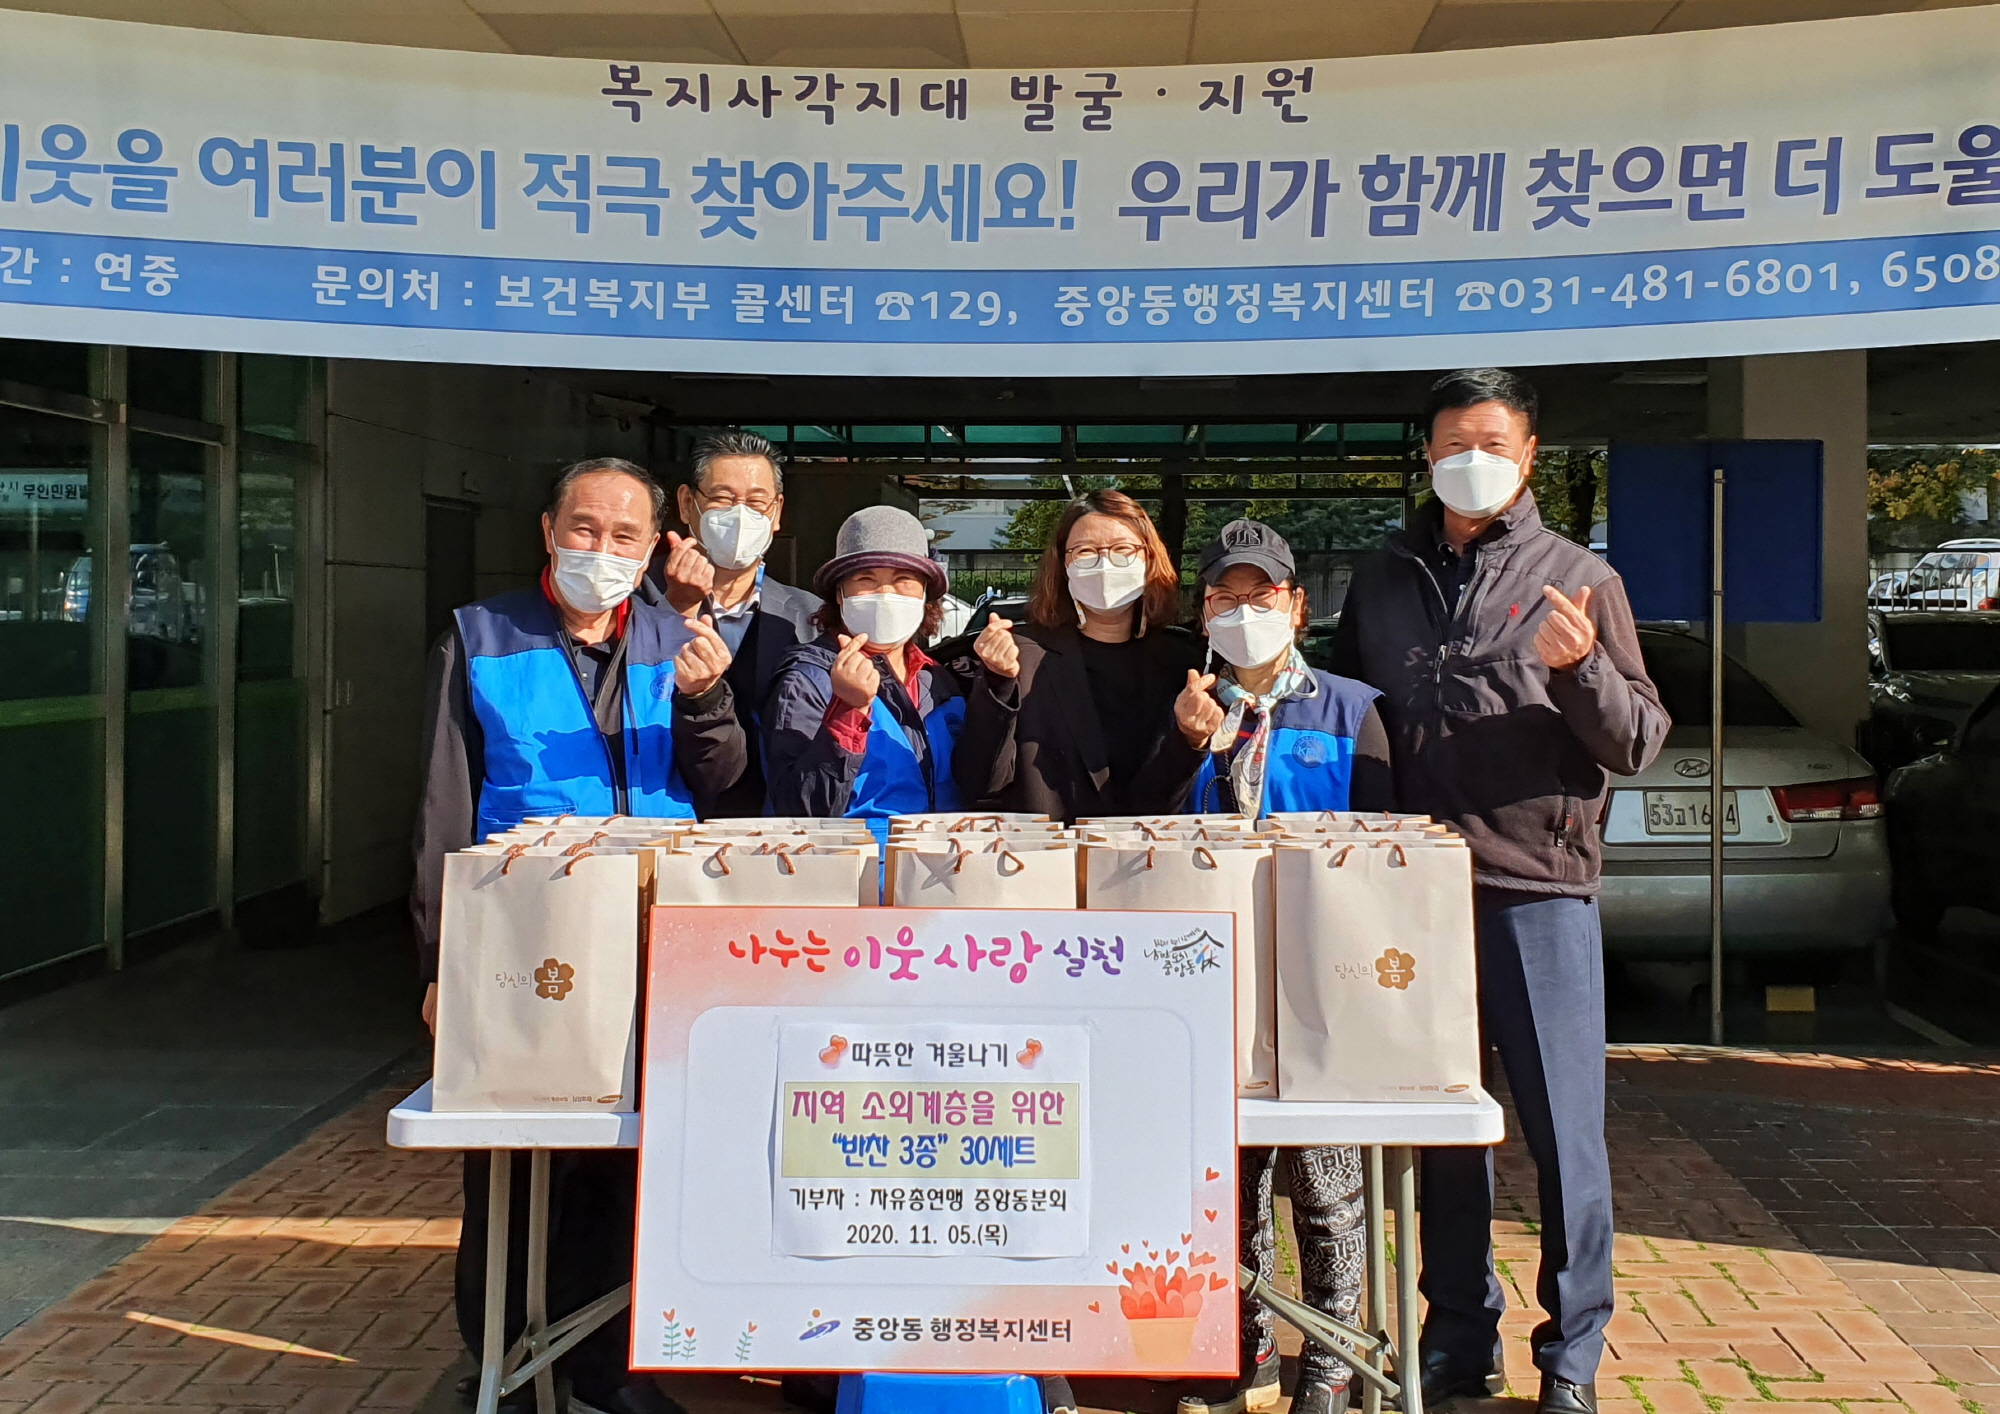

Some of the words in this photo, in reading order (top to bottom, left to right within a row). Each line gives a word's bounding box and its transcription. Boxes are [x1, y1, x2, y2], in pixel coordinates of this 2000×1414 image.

[601, 64, 968, 125] 복지사각지대
[1010, 73, 1122, 131] 발굴
[1198, 67, 1314, 122] 지원
[199, 137, 495, 229] 여러분이
[523, 153, 670, 236] 적극
[691, 158, 1077, 242] 찾아주세요!
[1119, 159, 1340, 241] 우리가
[1359, 153, 1505, 236] 함께
[1526, 142, 1747, 230] 찾으면
[1775, 137, 1842, 215] 더
[1866, 125, 2000, 205] 도울
[95, 253, 179, 296] 연중
[312, 266, 438, 310] 문의처
[496, 276, 710, 320] 보건복지부
[732, 284, 853, 324] 콜센터
[1054, 278, 1433, 327] 중앙동행정복지센터
[1883, 245, 2000, 292] 6508
[1649, 803, 1737, 826] 53고164
[729, 930, 830, 972] 나누는
[844, 926, 924, 980] 이웃
[934, 931, 1042, 983] 사랑
[1053, 936, 1123, 977] 실천
[495, 971, 533, 989] 당신의
[543, 966, 565, 994] 봄
[1162, 960, 1196, 978] 중앙동
[1334, 963, 1374, 979] 당신의
[1385, 956, 1406, 983] 봄
[853, 1042, 914, 1067] 따뜻한
[926, 1043, 1007, 1067] 겨울나기
[793, 1091, 844, 1124] 지역
[862, 1090, 994, 1126] 소외계층을
[1012, 1091, 1064, 1125] 위한
[960, 1136, 1035, 1167] 30세트
[790, 1189, 844, 1210] 기부자
[871, 1188, 962, 1211] 자유총연맹
[975, 1189, 1066, 1211] 중앙동분회
[847, 1225, 898, 1244] 2020.
[910, 1225, 937, 1244] 11.
[853, 1318, 923, 1341] 중앙동
[931, 1318, 1070, 1342] 행정복지센터
